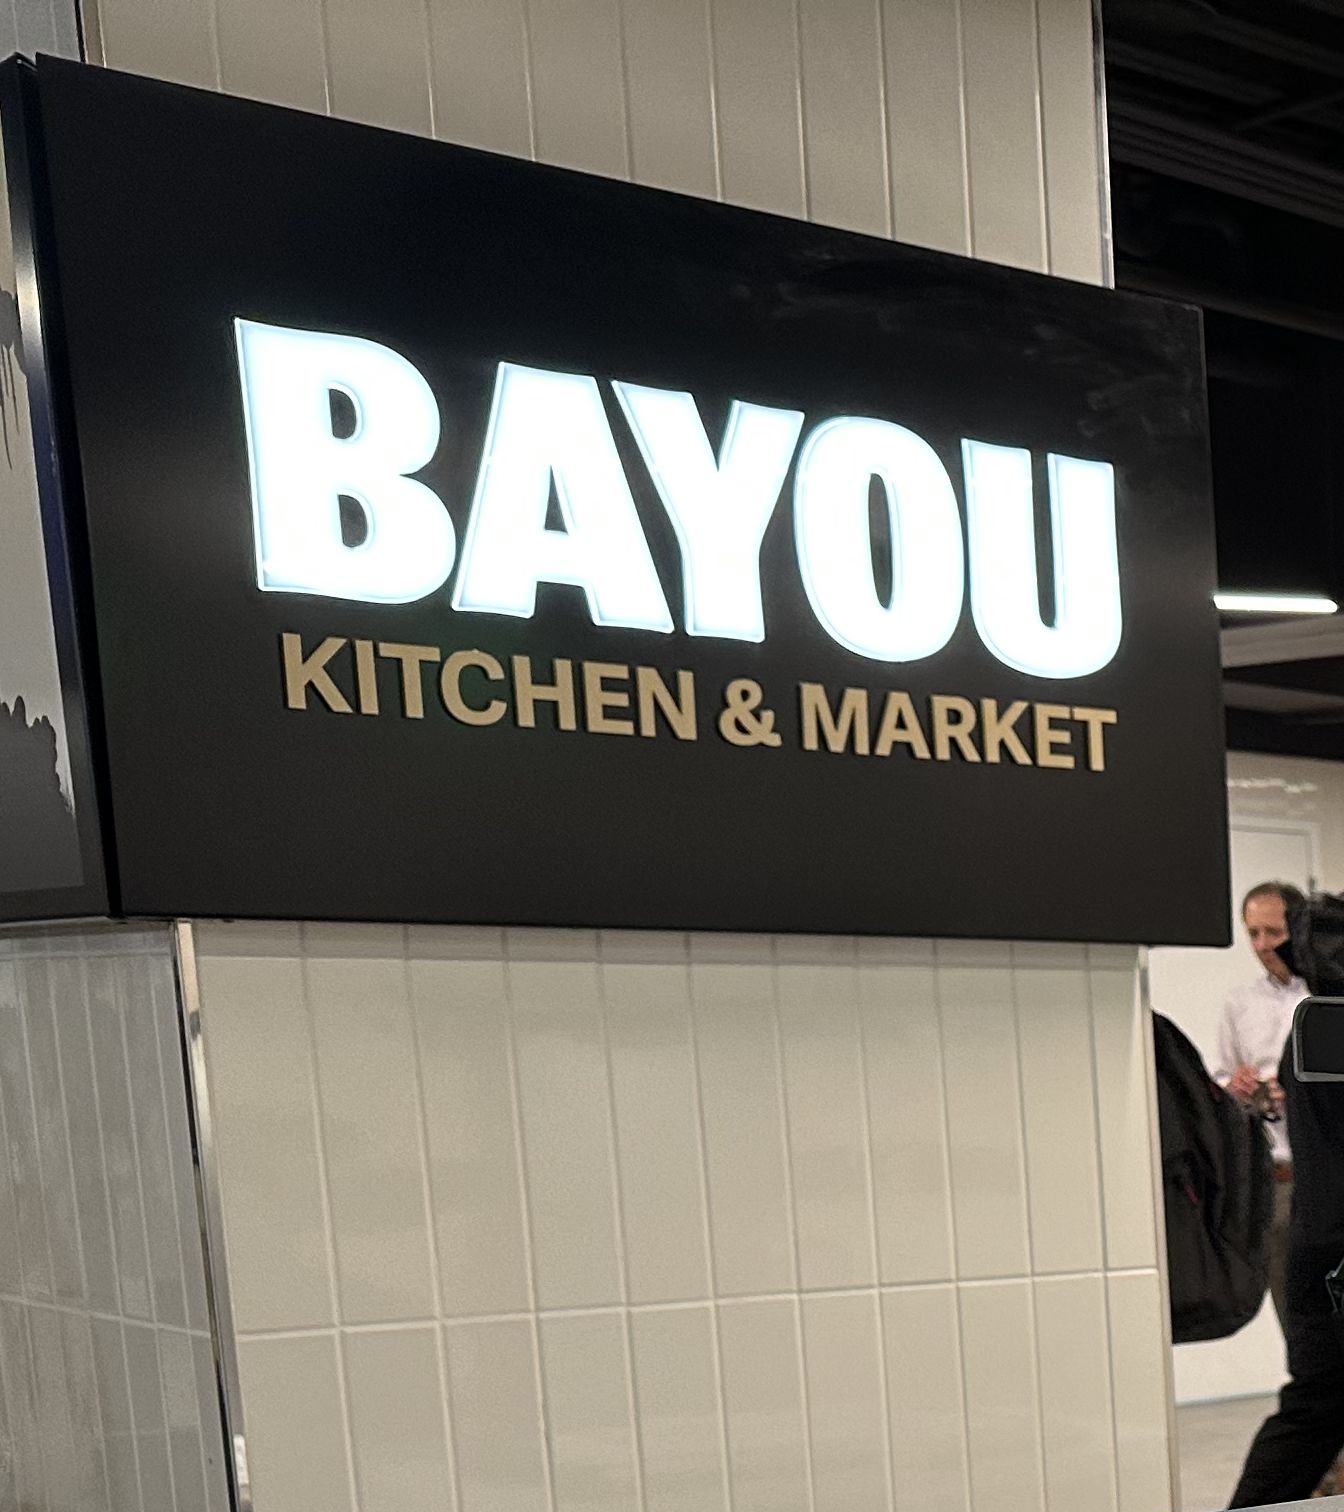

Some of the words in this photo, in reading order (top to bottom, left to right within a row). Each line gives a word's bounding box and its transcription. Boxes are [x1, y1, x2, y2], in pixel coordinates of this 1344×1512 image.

[232, 316, 1124, 680] BAYOU
[281, 631, 698, 743] KITCHEN
[717, 682, 783, 748] &
[799, 682, 1118, 773] MARKET
